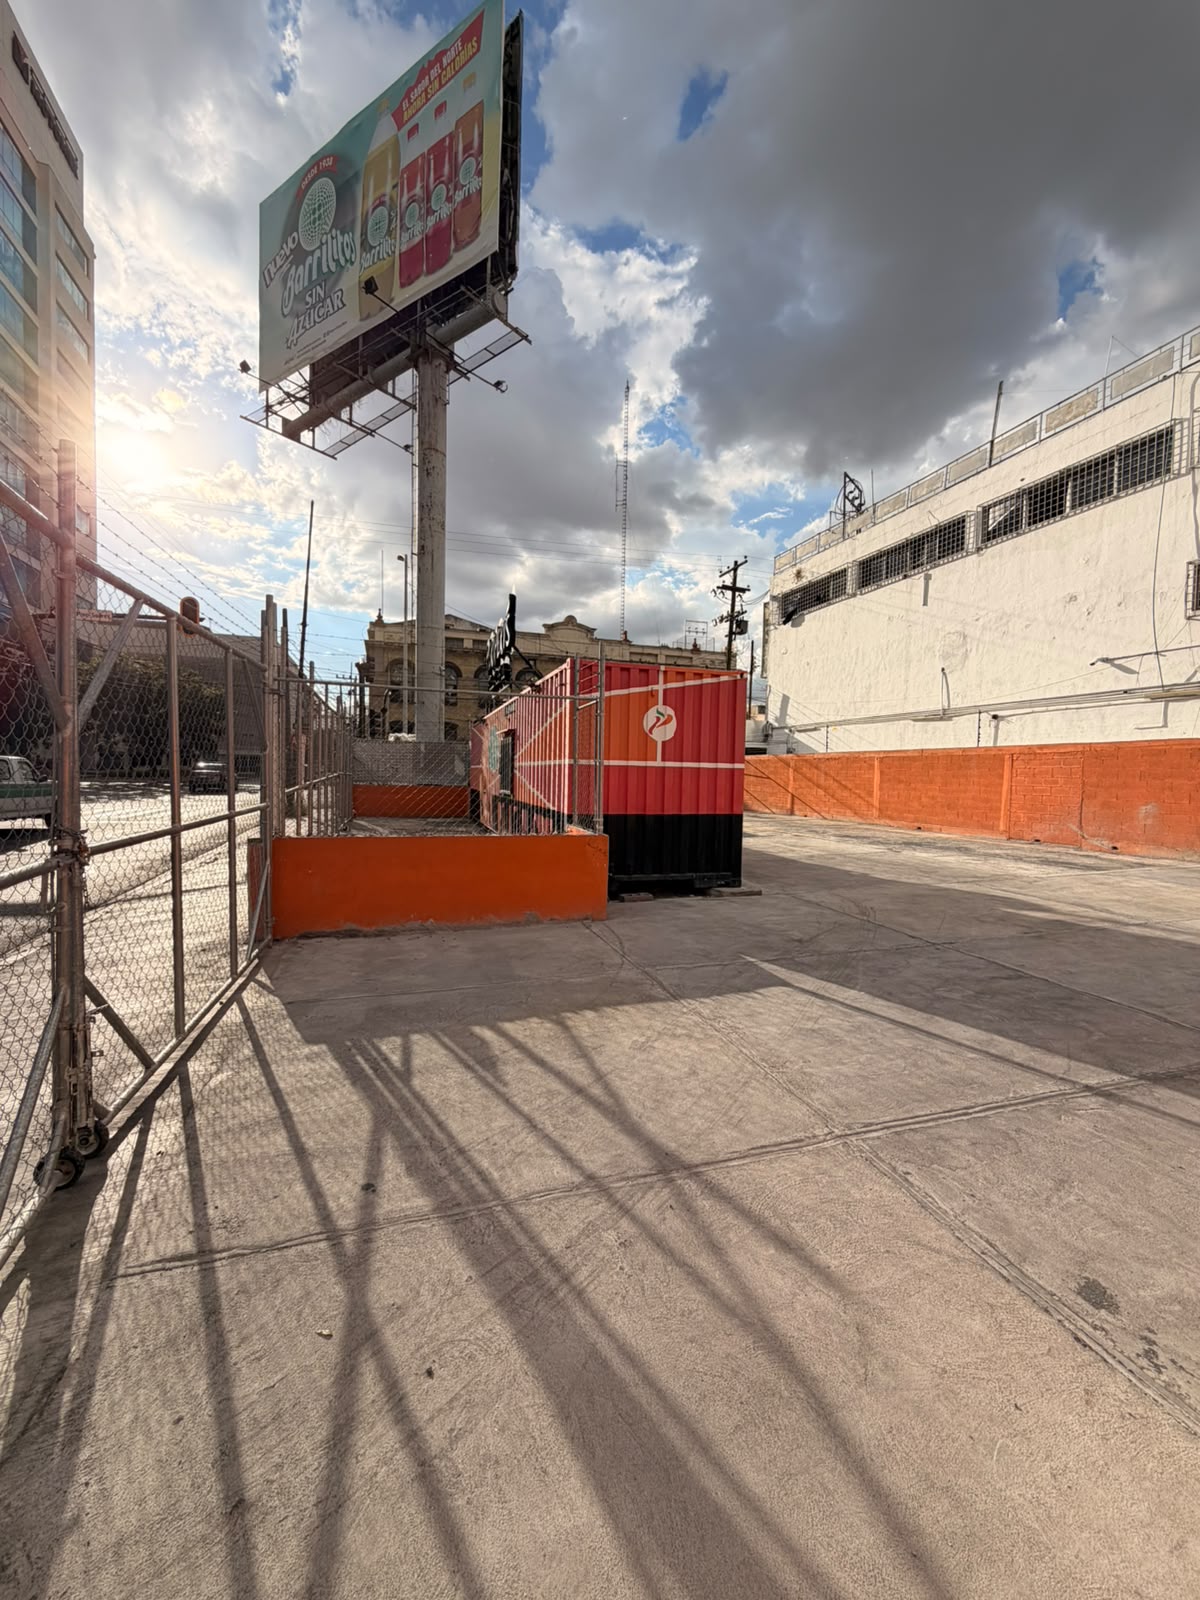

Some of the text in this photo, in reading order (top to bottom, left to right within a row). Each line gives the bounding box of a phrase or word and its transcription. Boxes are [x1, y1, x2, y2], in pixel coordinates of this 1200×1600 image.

[402, 38, 462, 112] EL SABOR DEL NORTE
[403, 91, 426, 122] AHORA
[427, 77, 440, 99] SIN
[301, 165, 318, 190] DESDE
[281, 228, 357, 317] Barrilitos
[304, 279, 326, 310] SIN
